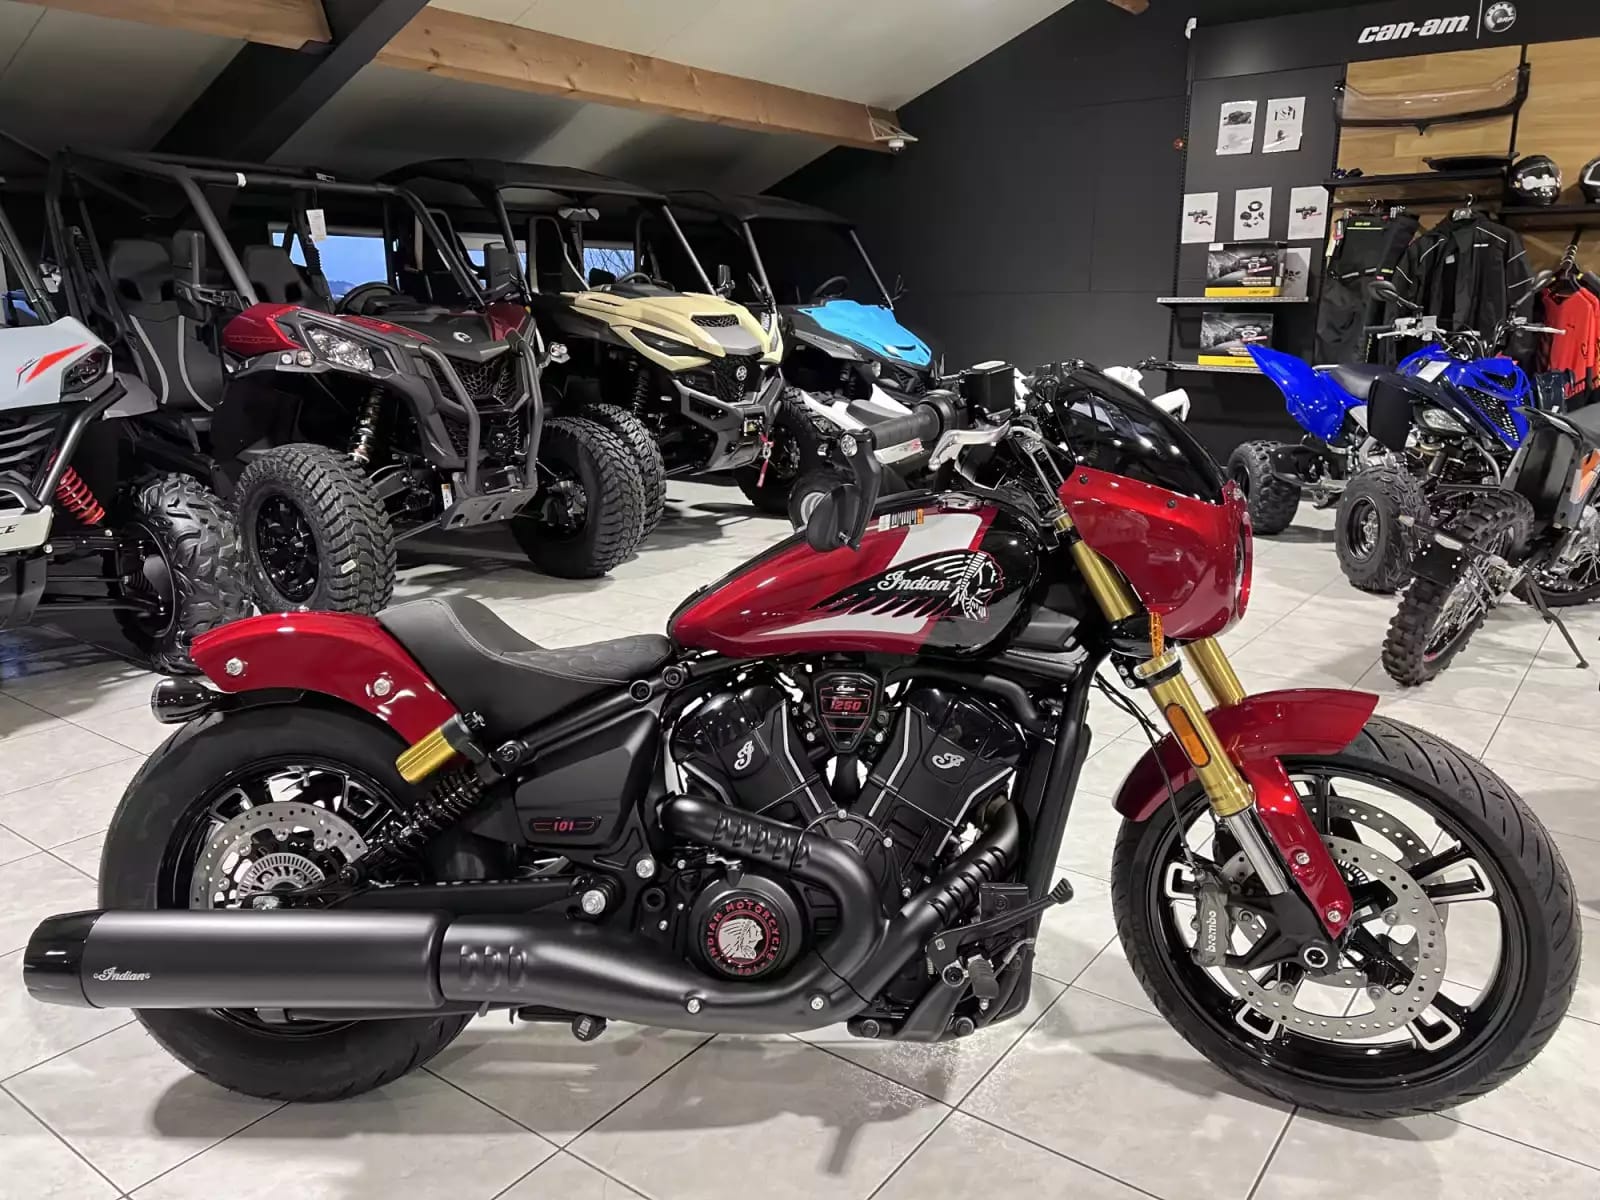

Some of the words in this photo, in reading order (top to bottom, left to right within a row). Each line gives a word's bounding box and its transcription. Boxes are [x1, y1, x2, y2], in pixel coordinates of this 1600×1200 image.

[877, 570, 951, 591] Indian
[831, 697, 862, 711] 1250
[553, 820, 575, 832] 101
[725, 901, 780, 960] MOTORCYCLE
[1205, 910, 1217, 953] brembo
[93, 966, 151, 981] Indian
